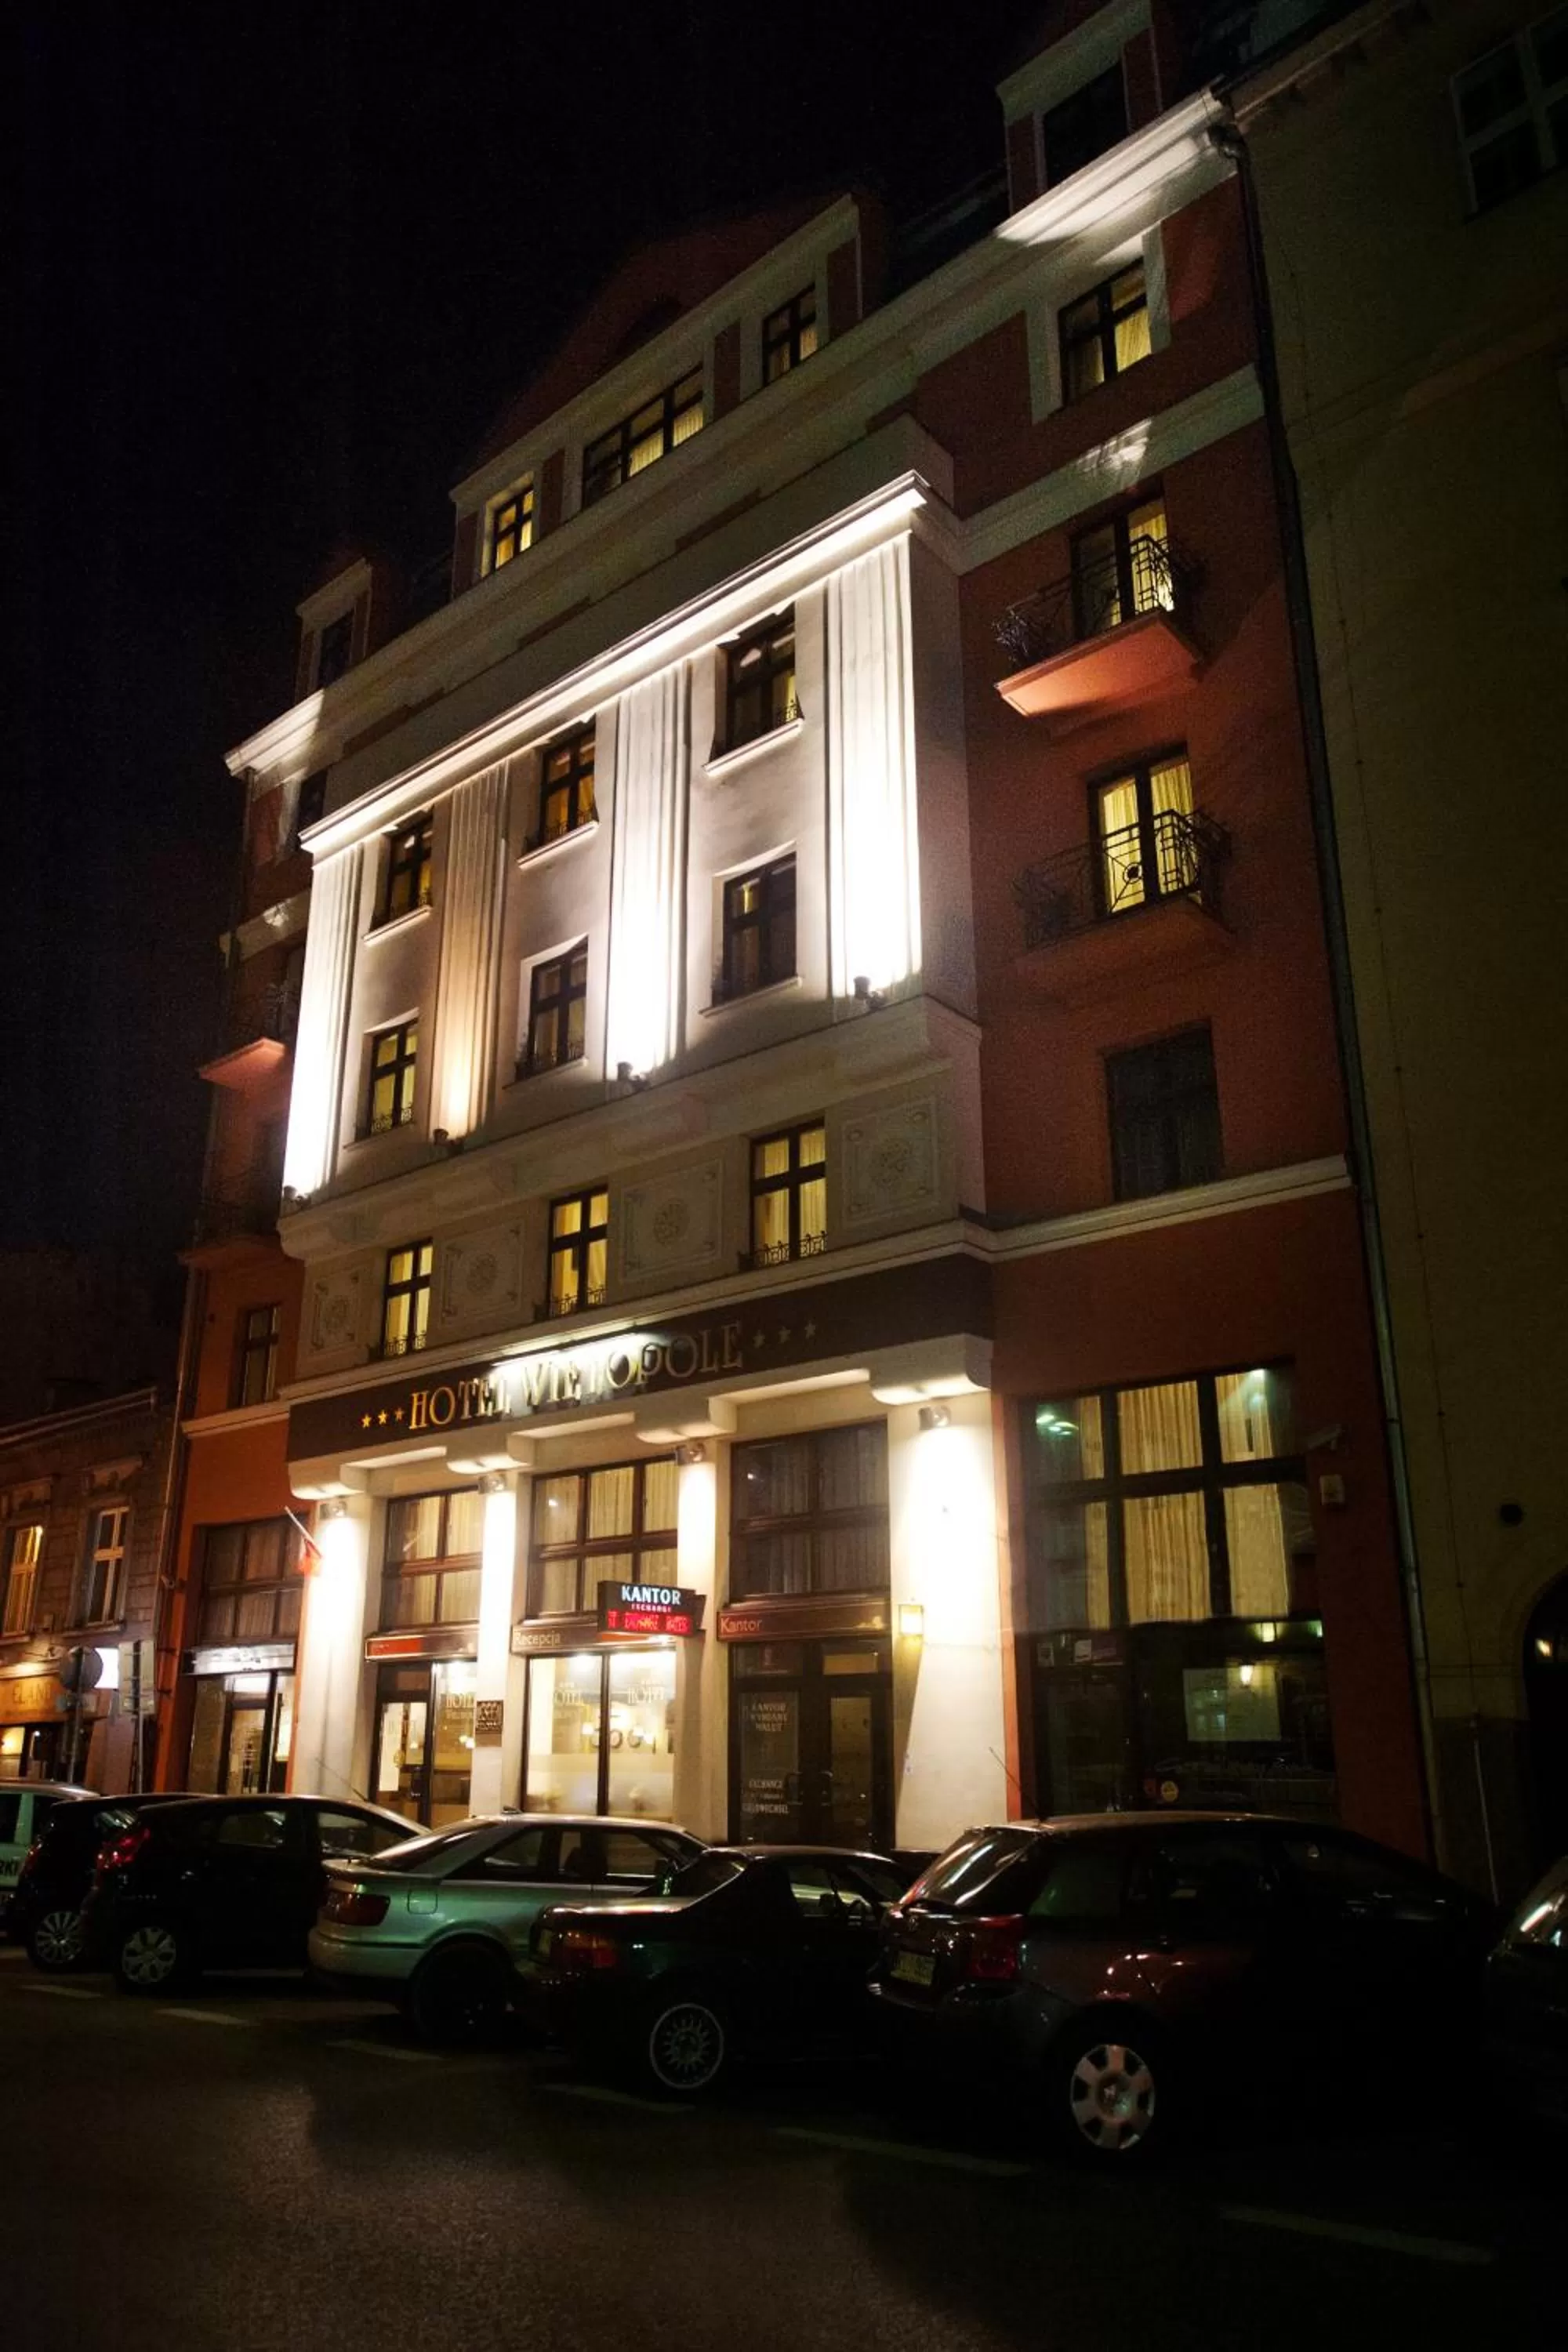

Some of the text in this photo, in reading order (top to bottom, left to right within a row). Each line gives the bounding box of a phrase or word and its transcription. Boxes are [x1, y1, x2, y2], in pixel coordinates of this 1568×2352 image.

[408, 1375, 512, 1430] HOTEL
[621, 1584, 681, 1606] KANTOR
[720, 1617, 763, 1633] Kantor
[514, 1630, 561, 1648] Recepcja
